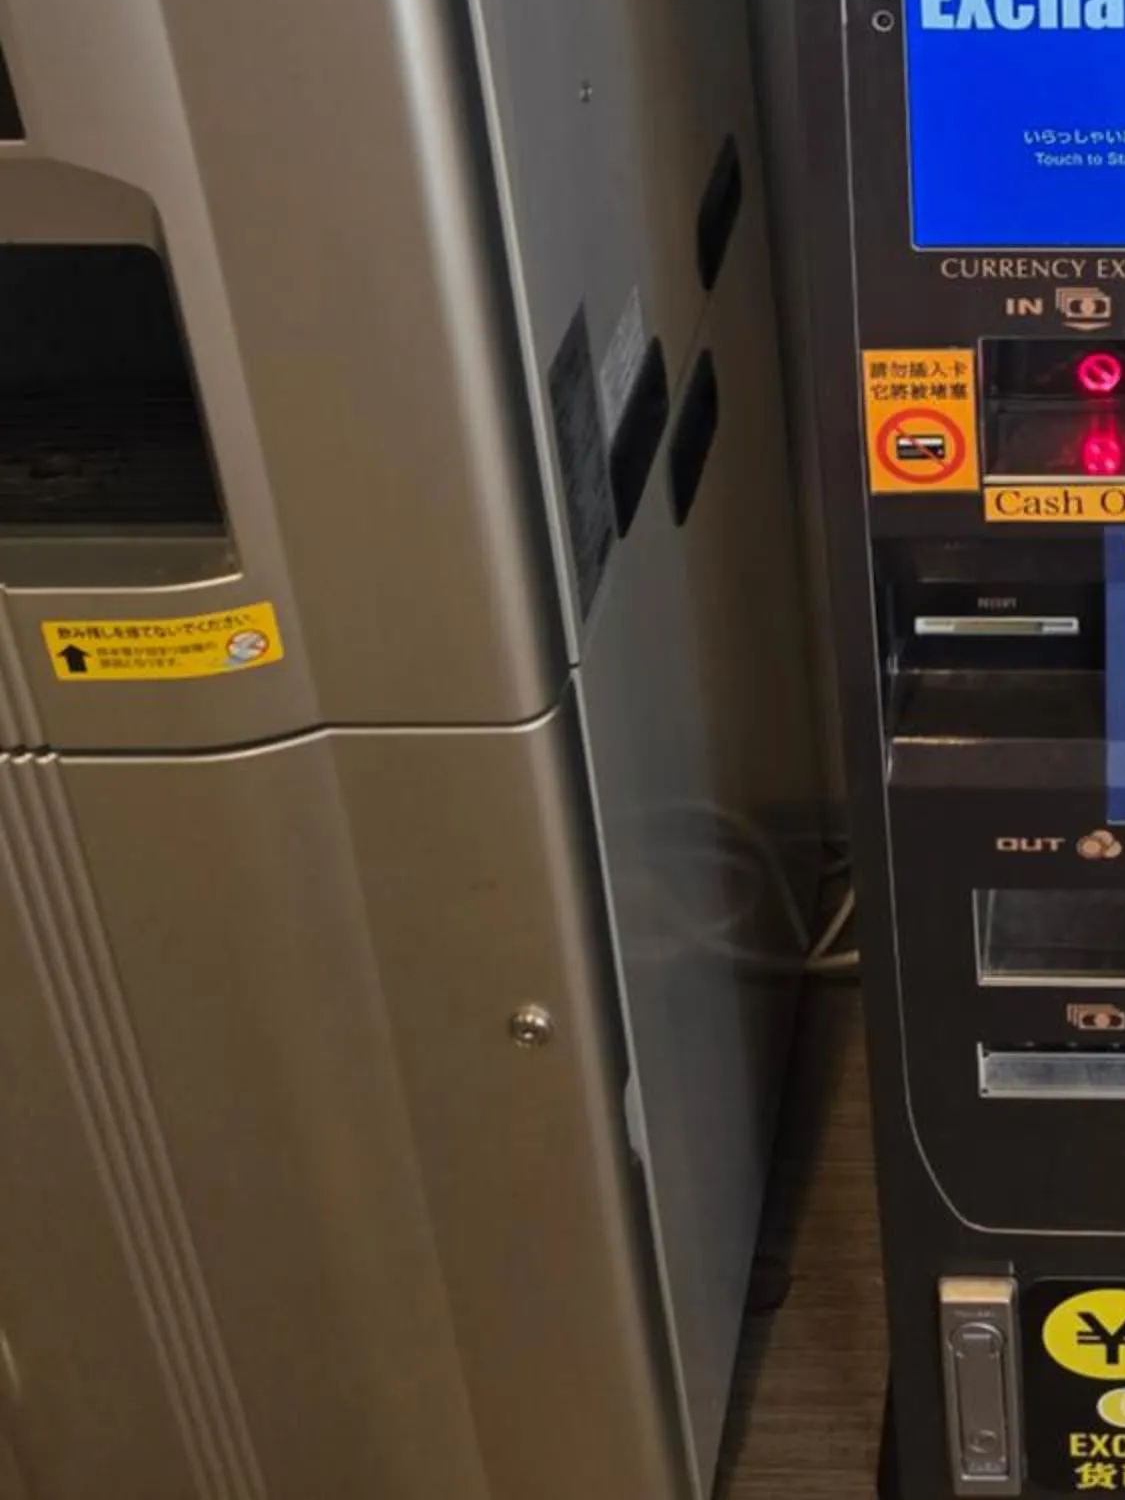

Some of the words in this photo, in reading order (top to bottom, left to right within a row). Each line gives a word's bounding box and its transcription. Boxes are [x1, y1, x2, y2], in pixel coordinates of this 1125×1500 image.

[1034, 151, 1083, 166] Touch
[1086, 152, 1103, 166] to
[940, 257, 1087, 279] CURRENCY
[1005, 297, 1044, 316] IN
[994, 486, 1085, 516] Cash
[995, 836, 1066, 852] OUT
